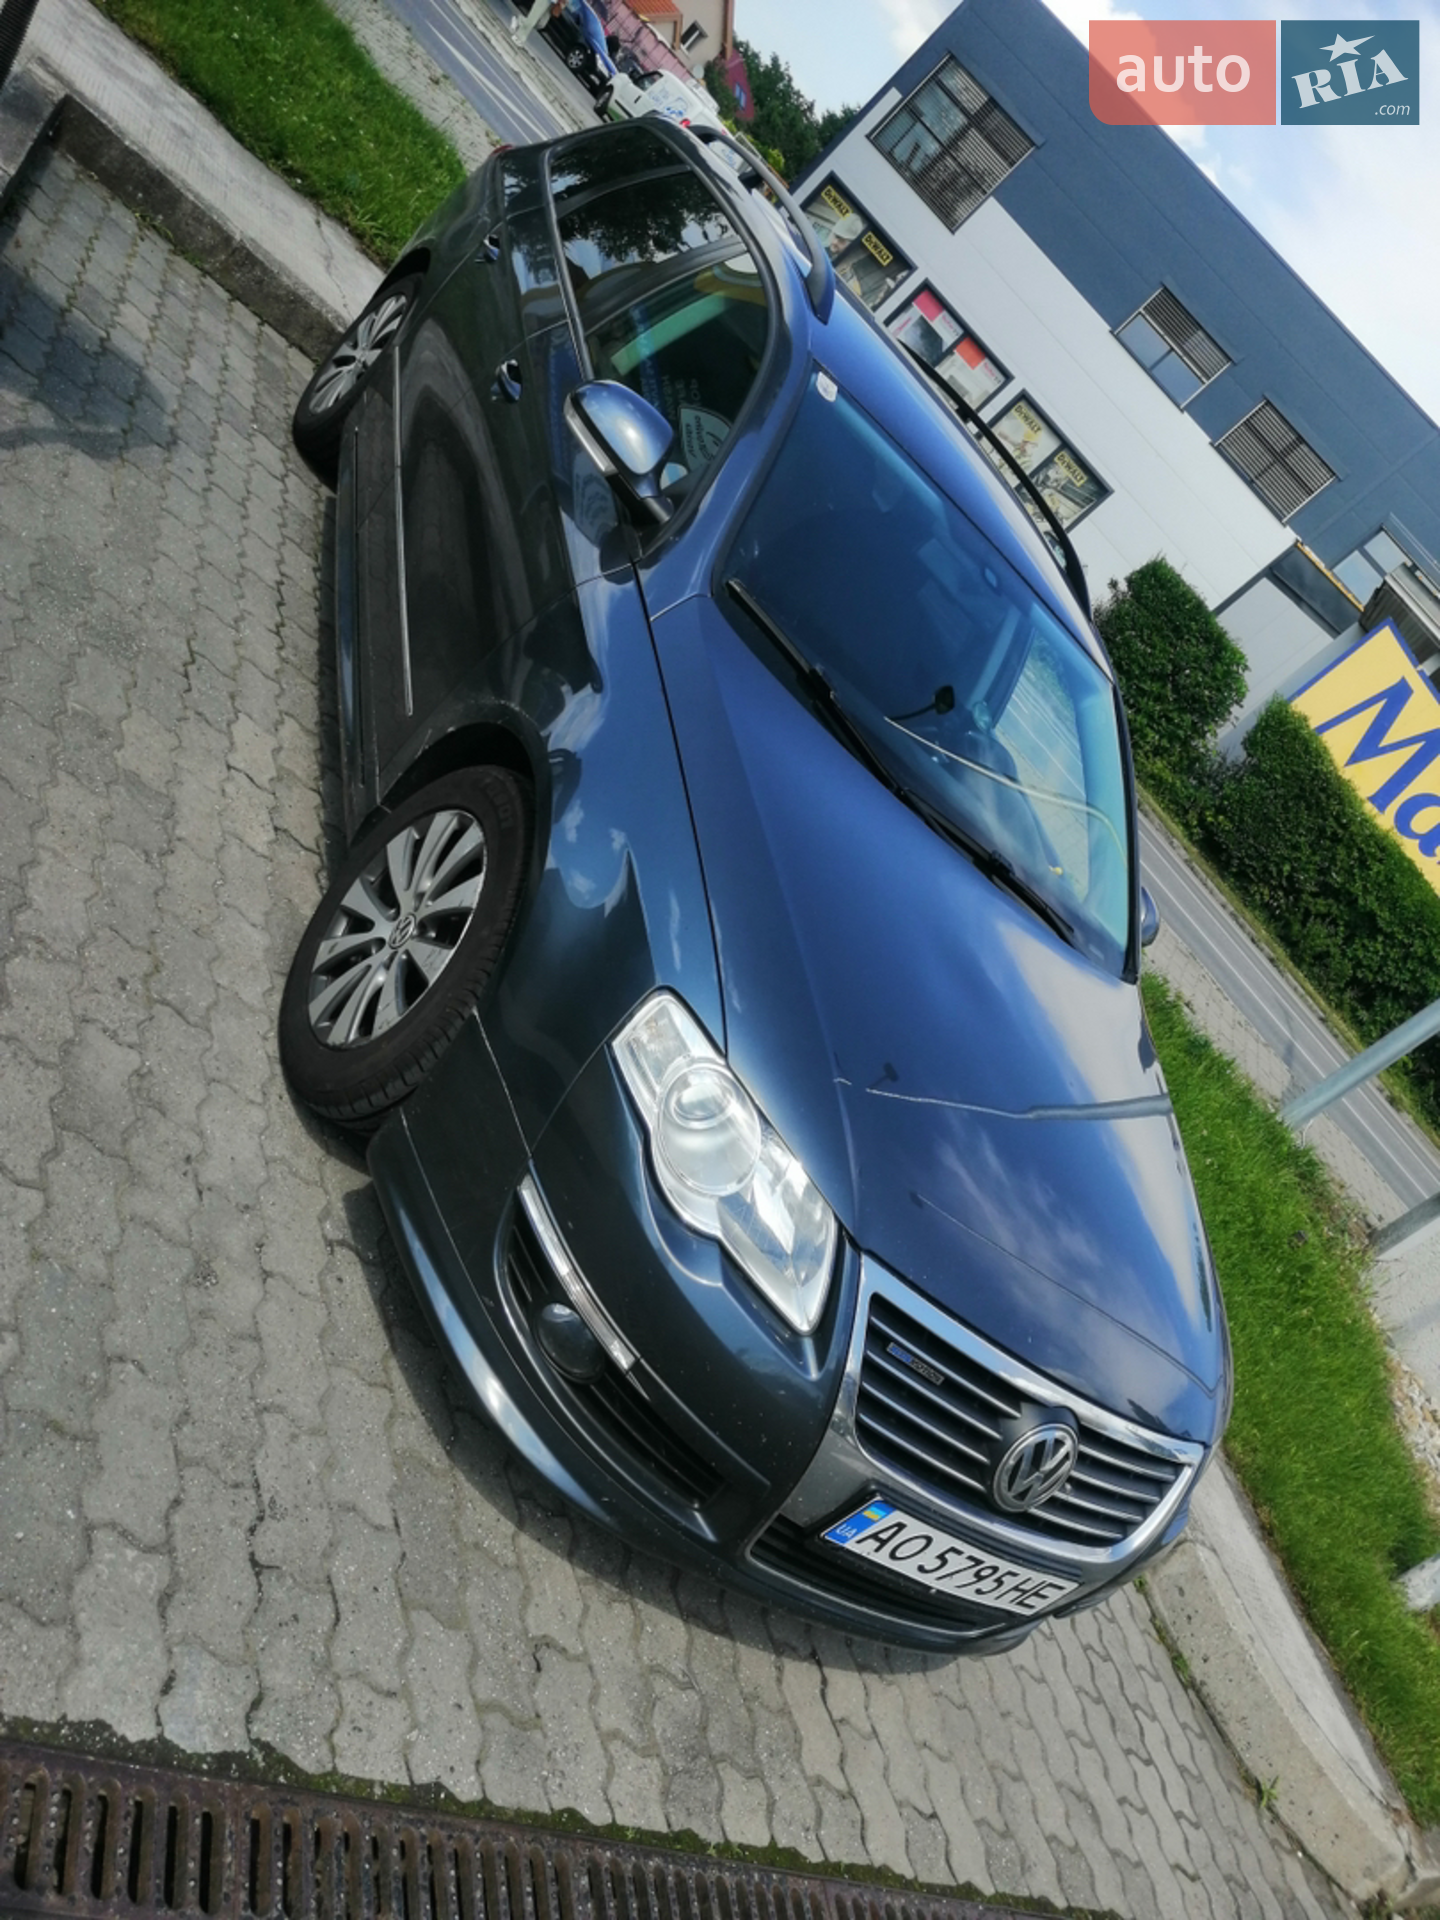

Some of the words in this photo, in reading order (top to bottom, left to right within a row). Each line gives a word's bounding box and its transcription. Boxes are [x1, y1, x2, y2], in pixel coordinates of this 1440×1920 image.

[864, 233, 891, 264] DEWALT
[1013, 404, 1042, 434] DEWALT
[1056, 453, 1085, 484] DEWALT
[854, 1521, 934, 1561] AO
[916, 1546, 1020, 1596] 5795
[995, 1576, 1066, 1610] HE
